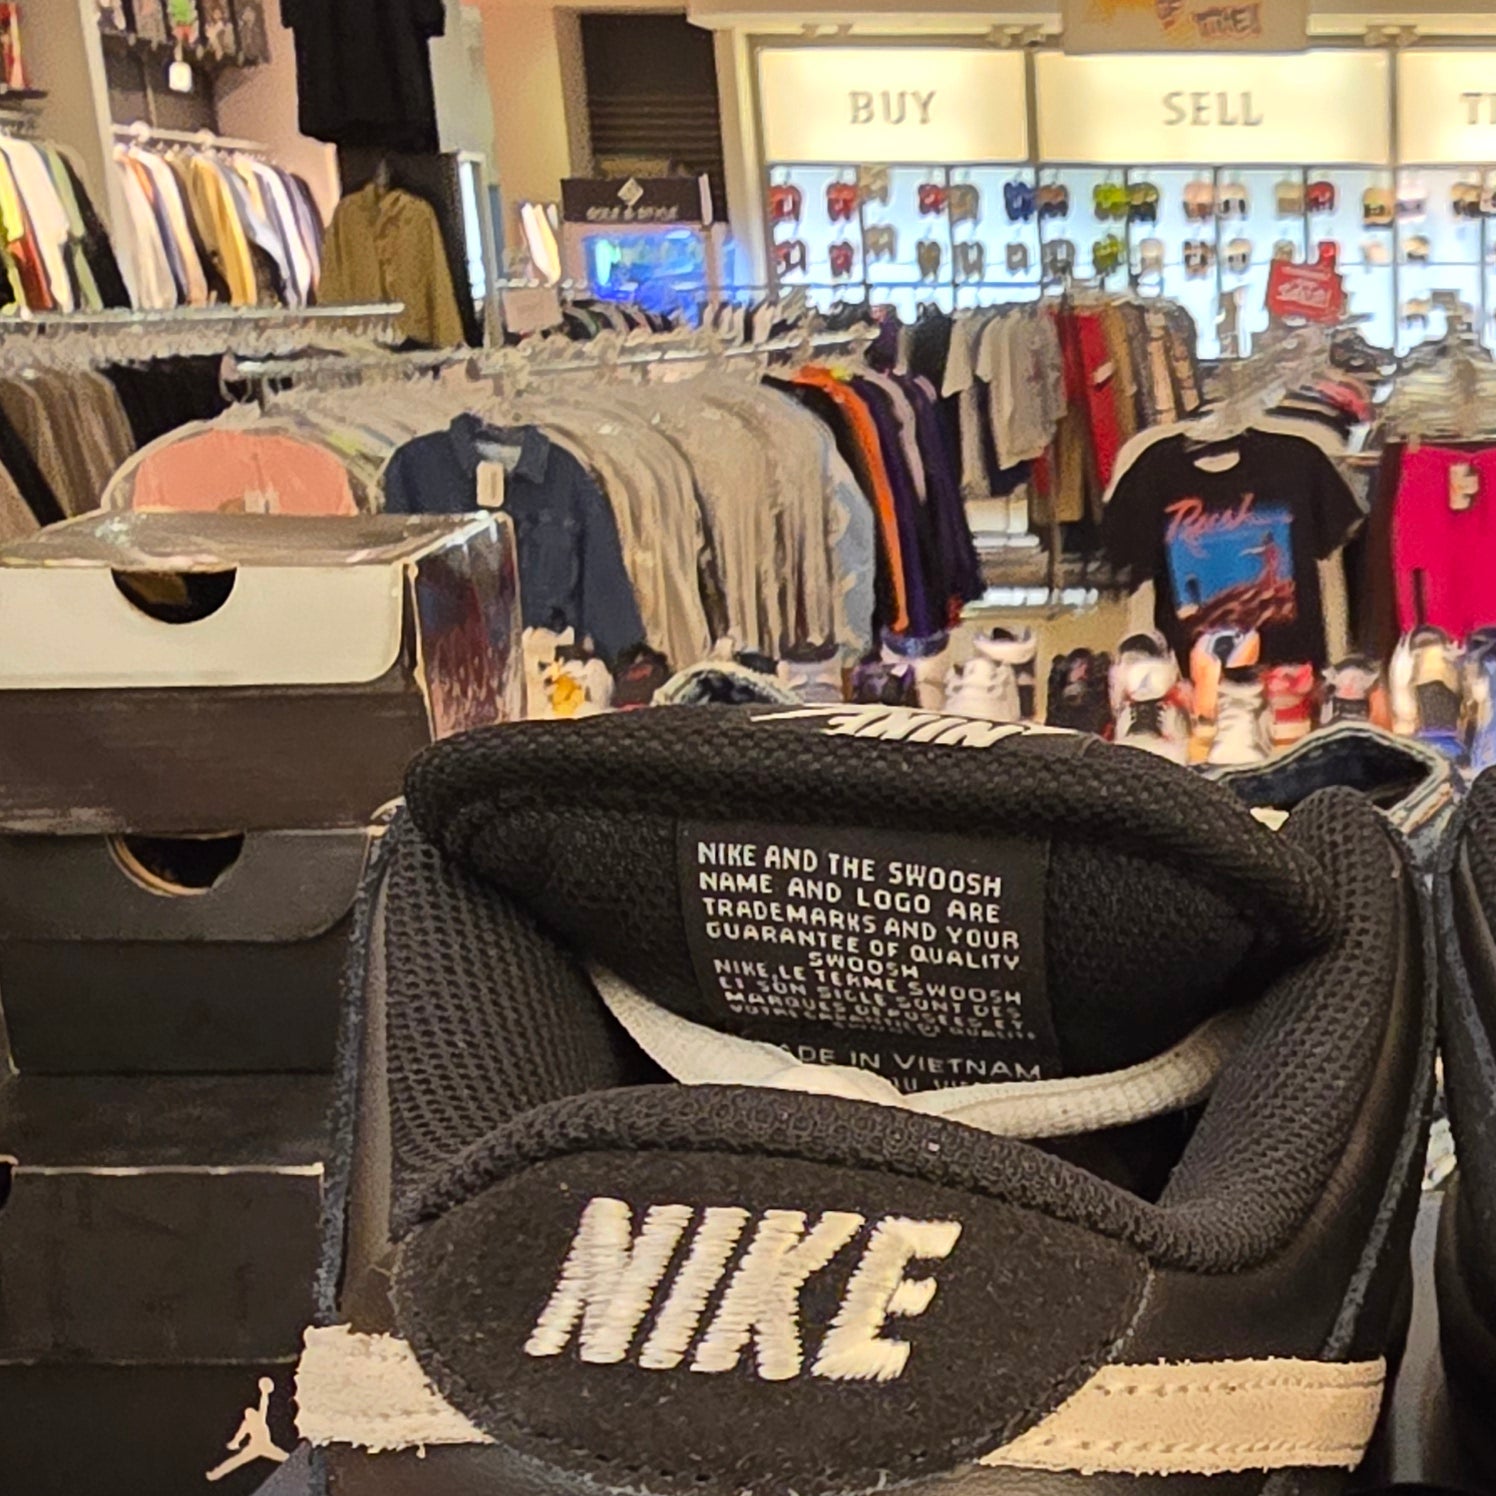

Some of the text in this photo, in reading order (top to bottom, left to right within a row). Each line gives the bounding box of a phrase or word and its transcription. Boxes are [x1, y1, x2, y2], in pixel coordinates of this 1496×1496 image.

[848, 90, 936, 125] BUY
[1162, 91, 1263, 127] SELL
[698, 842, 1001, 898] NIKE AND THE SWOOSH
[700, 872, 1000, 923] NAME AND LOGO ARE
[702, 897, 1019, 950] TRADEMARKS AND YOUR
[706, 921, 1020, 970] GUARANTEE OF QUALITY
[808, 951, 919, 979] SWOOSH
[908, 981, 1022, 1005] SWOOSH
[781, 1043, 1041, 1080] DE IN VIETNAM
[523, 1197, 962, 1382] NIKE
